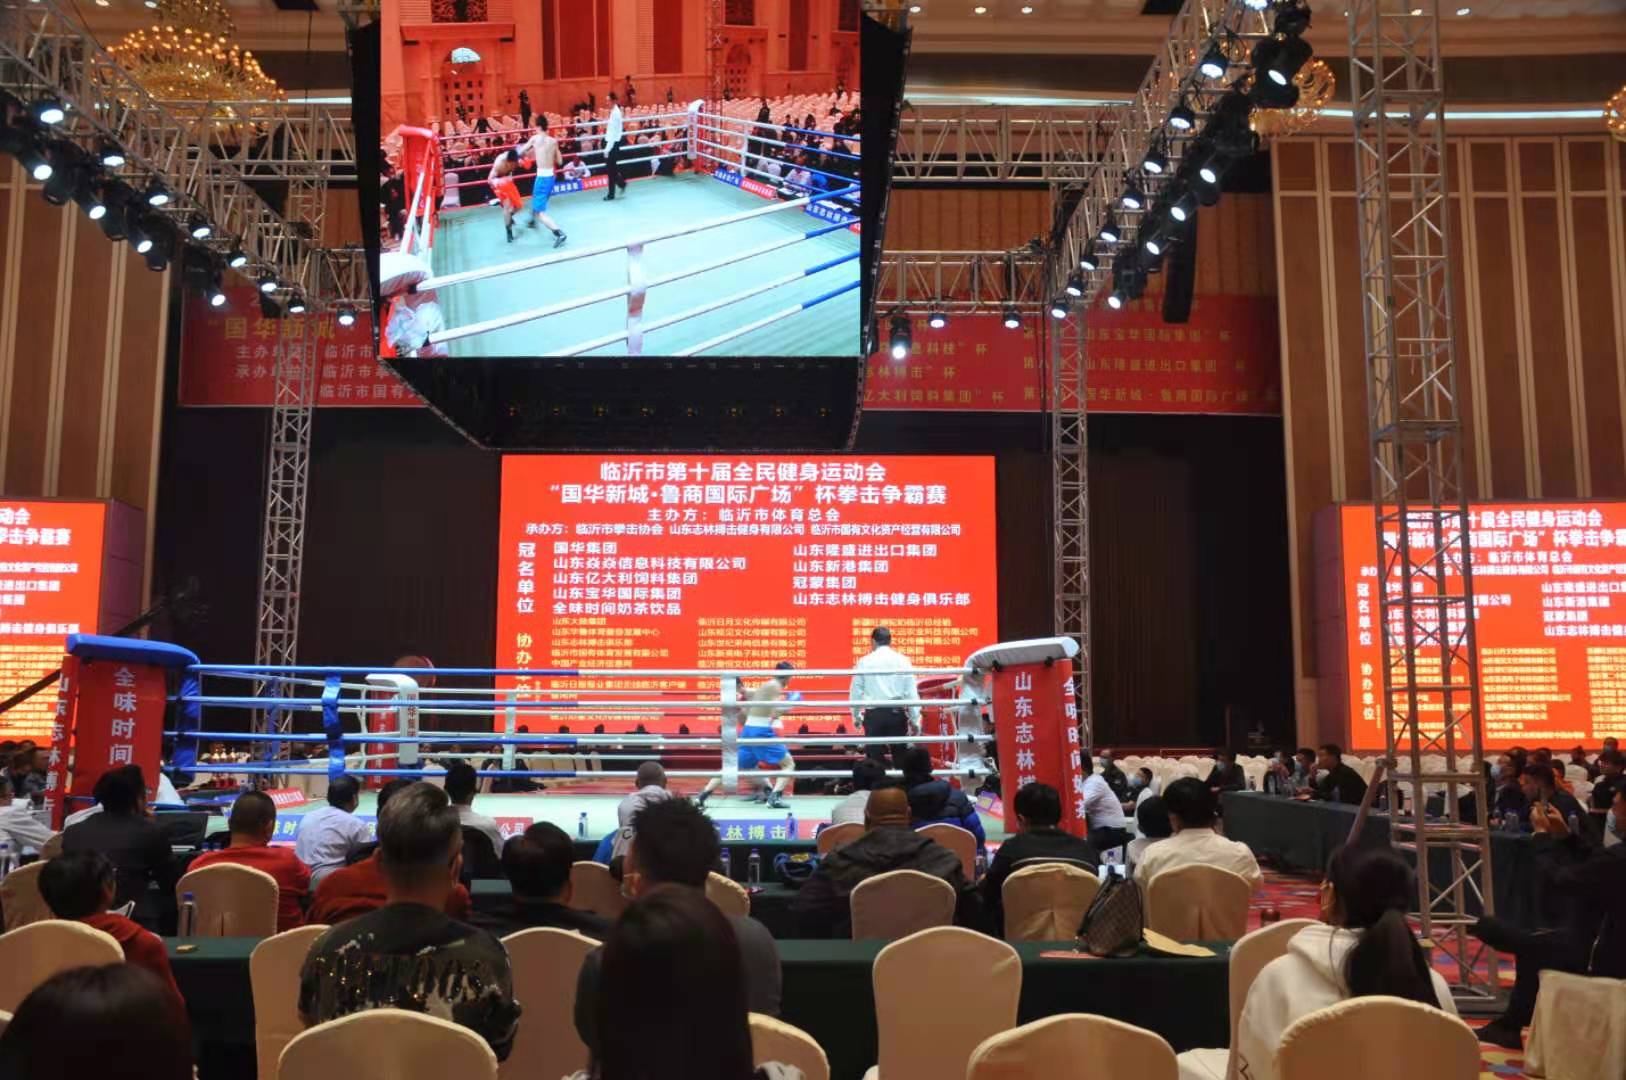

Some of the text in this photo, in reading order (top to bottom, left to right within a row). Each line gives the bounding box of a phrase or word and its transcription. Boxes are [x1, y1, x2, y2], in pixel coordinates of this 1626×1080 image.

[601, 462, 885, 482] 临沂市第十届全民健身运动会
[554, 542, 617, 554] 国华集团
[794, 544, 936, 556] 山东隆盛进出口集团
[794, 560, 888, 572] 山东新港集团
[517, 543, 535, 612] 冠名单位
[554, 572, 697, 584] 山东亿大利饲料集团
[794, 576, 856, 589] 冠蒙集团
[554, 587, 681, 600] 山东宝华国际集团
[794, 593, 970, 605] 山东志林搏击健身俱乐部
[553, 602, 681, 615] 全味时间奶茶饮品
[713, 824, 787, 840] 林搏击
